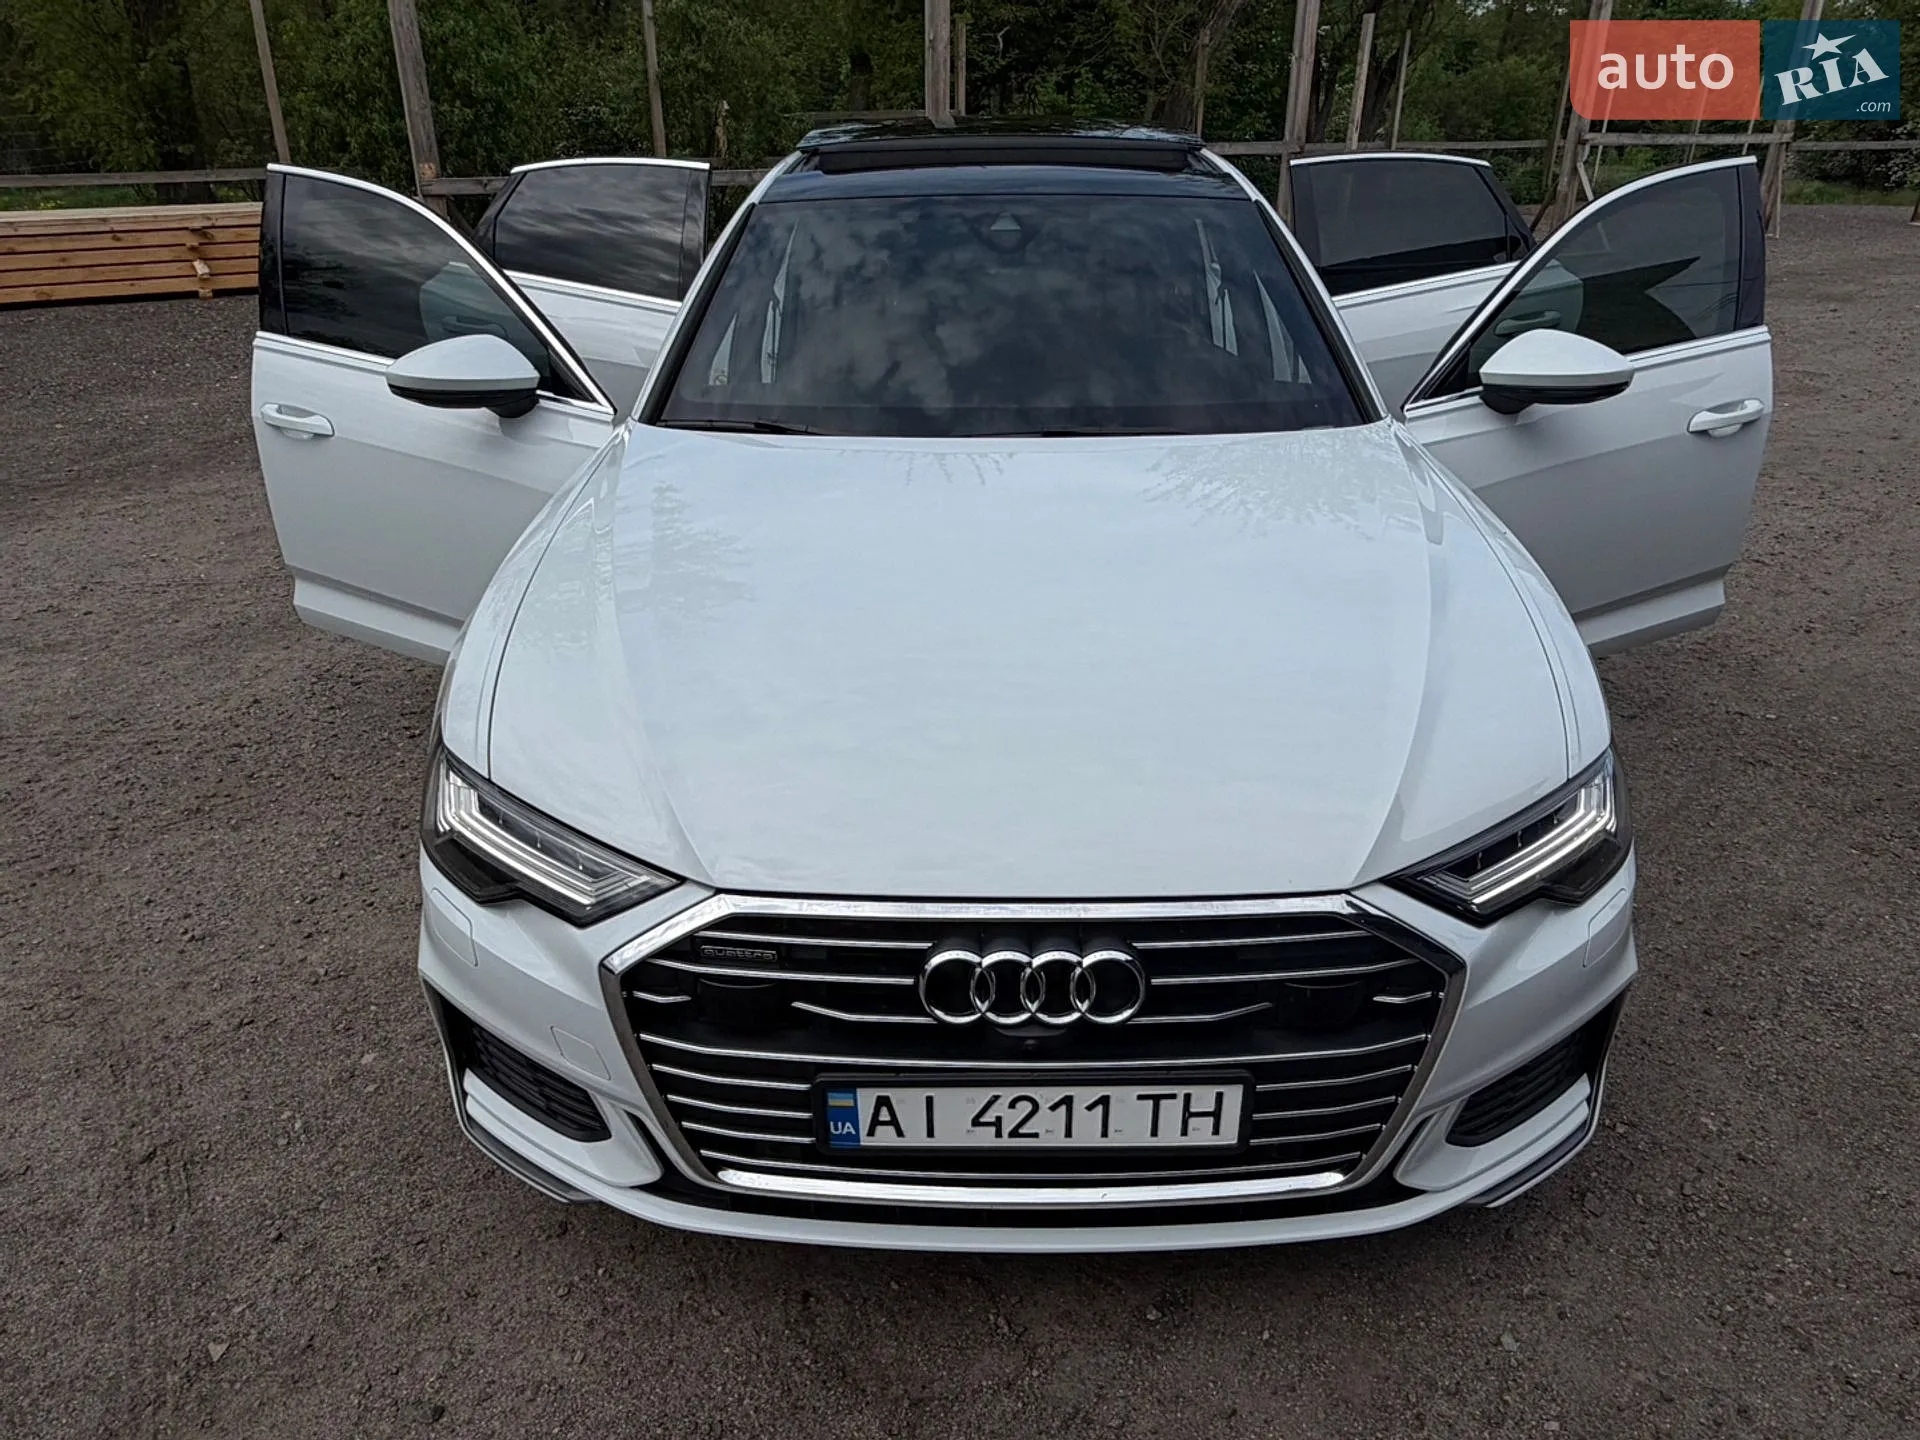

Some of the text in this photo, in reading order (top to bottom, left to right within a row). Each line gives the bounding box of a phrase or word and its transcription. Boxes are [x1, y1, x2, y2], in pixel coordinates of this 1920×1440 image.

[829, 1121, 856, 1135] UA
[866, 1091, 1223, 1138] AI 4211 TH
